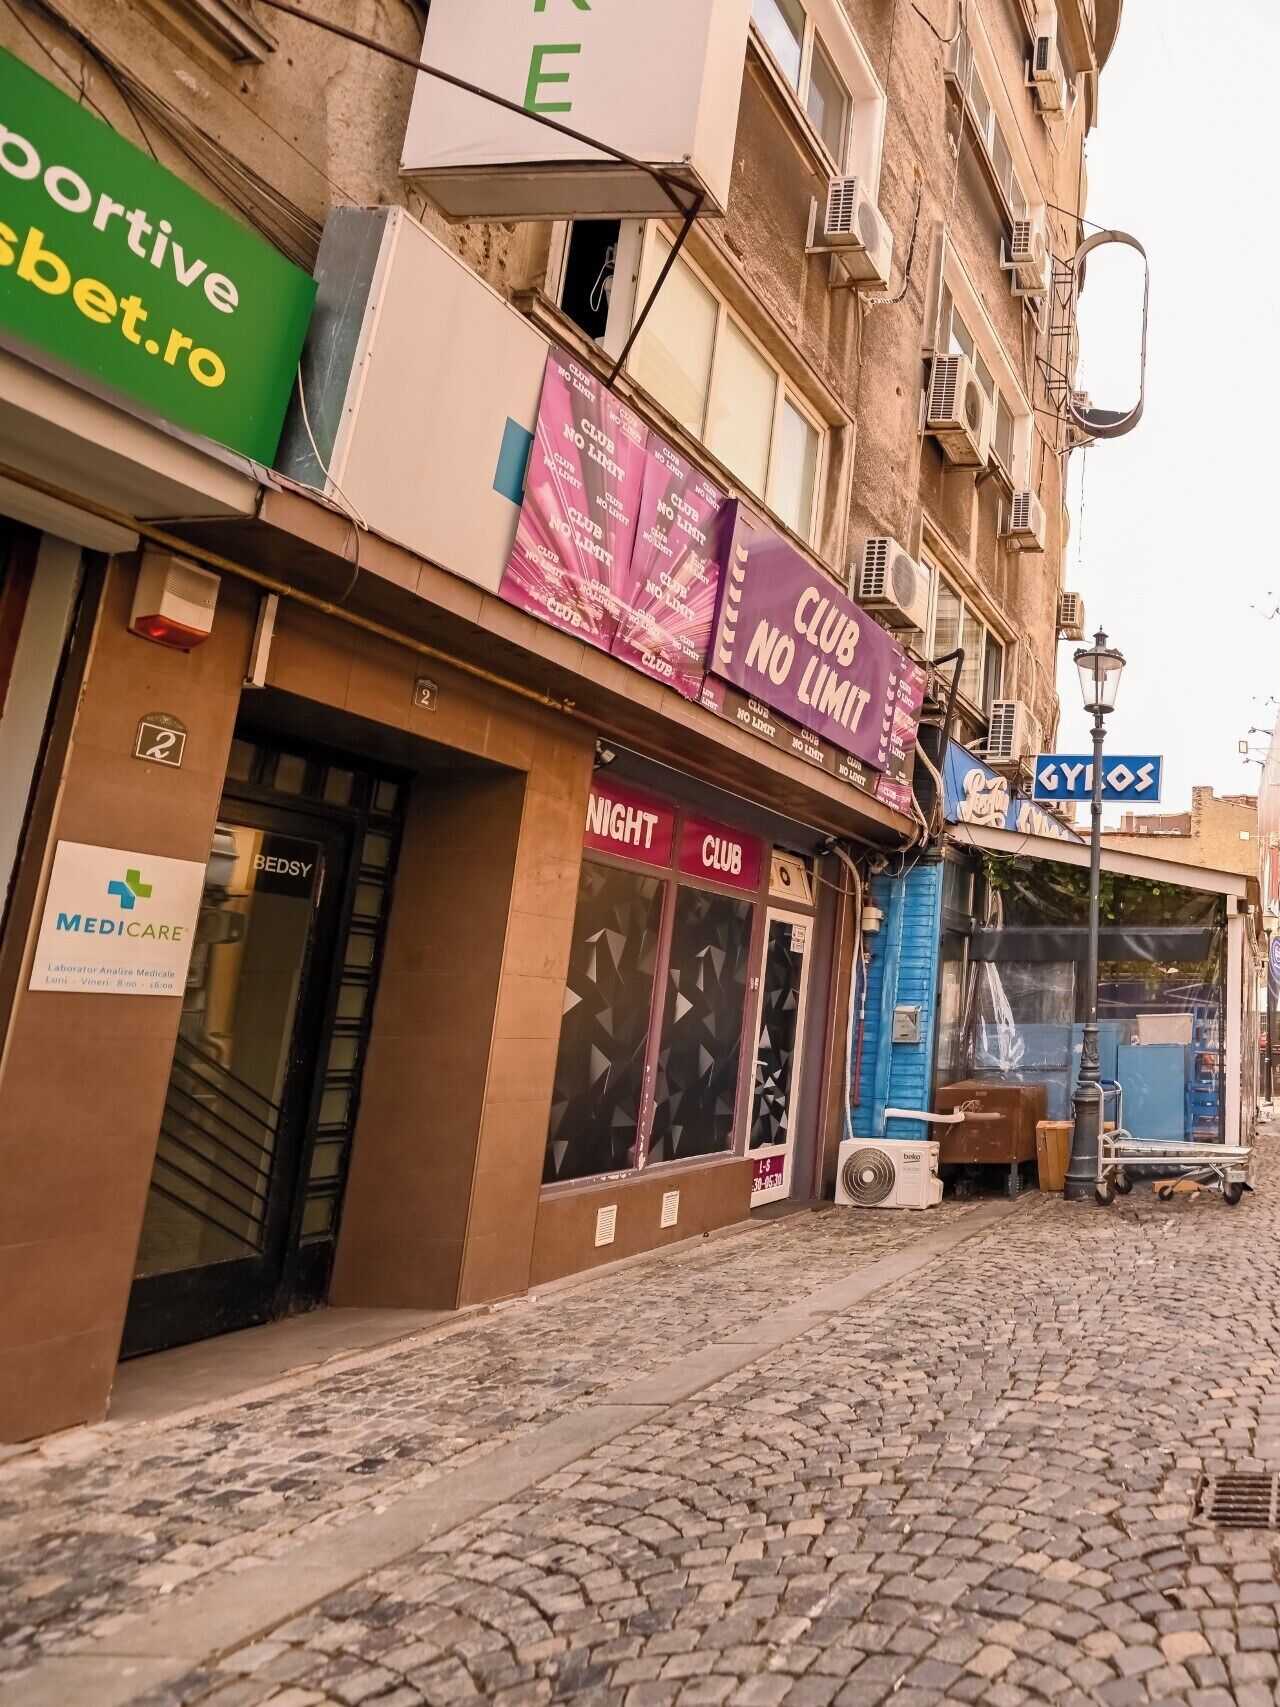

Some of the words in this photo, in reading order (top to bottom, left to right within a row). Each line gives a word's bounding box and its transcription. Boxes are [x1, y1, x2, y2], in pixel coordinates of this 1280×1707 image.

[558, 366, 571, 381] NO
[573, 377, 596, 402] LIMIT
[569, 364, 590, 386] CLUB
[609, 411, 621, 425] NO
[622, 421, 642, 444] LIMIT
[619, 409, 638, 428] CLUB
[581, 419, 615, 454] CLUB
[554, 453, 576, 473] CLUB
[563, 423, 585, 449] NO
[588, 443, 625, 482] LIMIT
[655, 451, 664, 463] NO
[666, 461, 684, 480] LIMIT
[663, 448, 679, 466] CLUB
[544, 456, 556, 470] NO
[558, 465, 582, 489] LIMIT
[596, 496, 607, 510] NO
[609, 507, 629, 526] LIMIT
[605, 493, 624, 511] CLUB
[671, 493, 699, 521] CLUB
[567, 507, 603, 541] CLUB
[651, 527, 668, 543] CLUB
[657, 499, 674, 520] NO
[677, 514, 706, 546] LIMIT
[549, 515, 571, 538] NO
[574, 535, 613, 567] LIMIT
[643, 531, 653, 543] NO
[538, 545, 559, 563] CLUB
[660, 572, 687, 599] CLUB
[547, 598, 582, 628] CLUB
[645, 579, 663, 600] NO
[666, 594, 695, 622] LIMIT
[794, 586, 860, 667] CLUB
[642, 652, 673, 678] CLUB
[744, 618, 796, 686] NO
[798, 655, 870, 734] LIMIT
[421, 689, 431, 705] 2
[701, 697, 718, 710] LIMIT
[702, 687, 714, 699] LUB
[737, 707, 751, 724] NO
[752, 716, 776, 738] LIMIT
[748, 699, 770, 719] CLUB
[146, 732, 177, 759] 2
[792, 737, 803, 751] NO
[805, 745, 825, 764] LIMIT
[801, 729, 820, 747] CLUB
[839, 764, 849, 776] NO
[849, 770, 867, 787] LIMIT
[846, 755, 862, 771] CLUB
[585, 793, 659, 849] NIGHT
[253, 854, 313, 877] BEDSY
[702, 834, 742, 875] CLUB
[56, 913, 183, 941] MEDICARE
[45, 975, 68, 985] Luni
[117, 980, 137, 988] 8:00
[149, 982, 174, 990] 16:00
[48, 963, 97, 974] Laborator
[100, 966, 134, 976] Analize
[136, 968, 175, 979] Medicale
[759, 1158, 771, 1174] L-S
